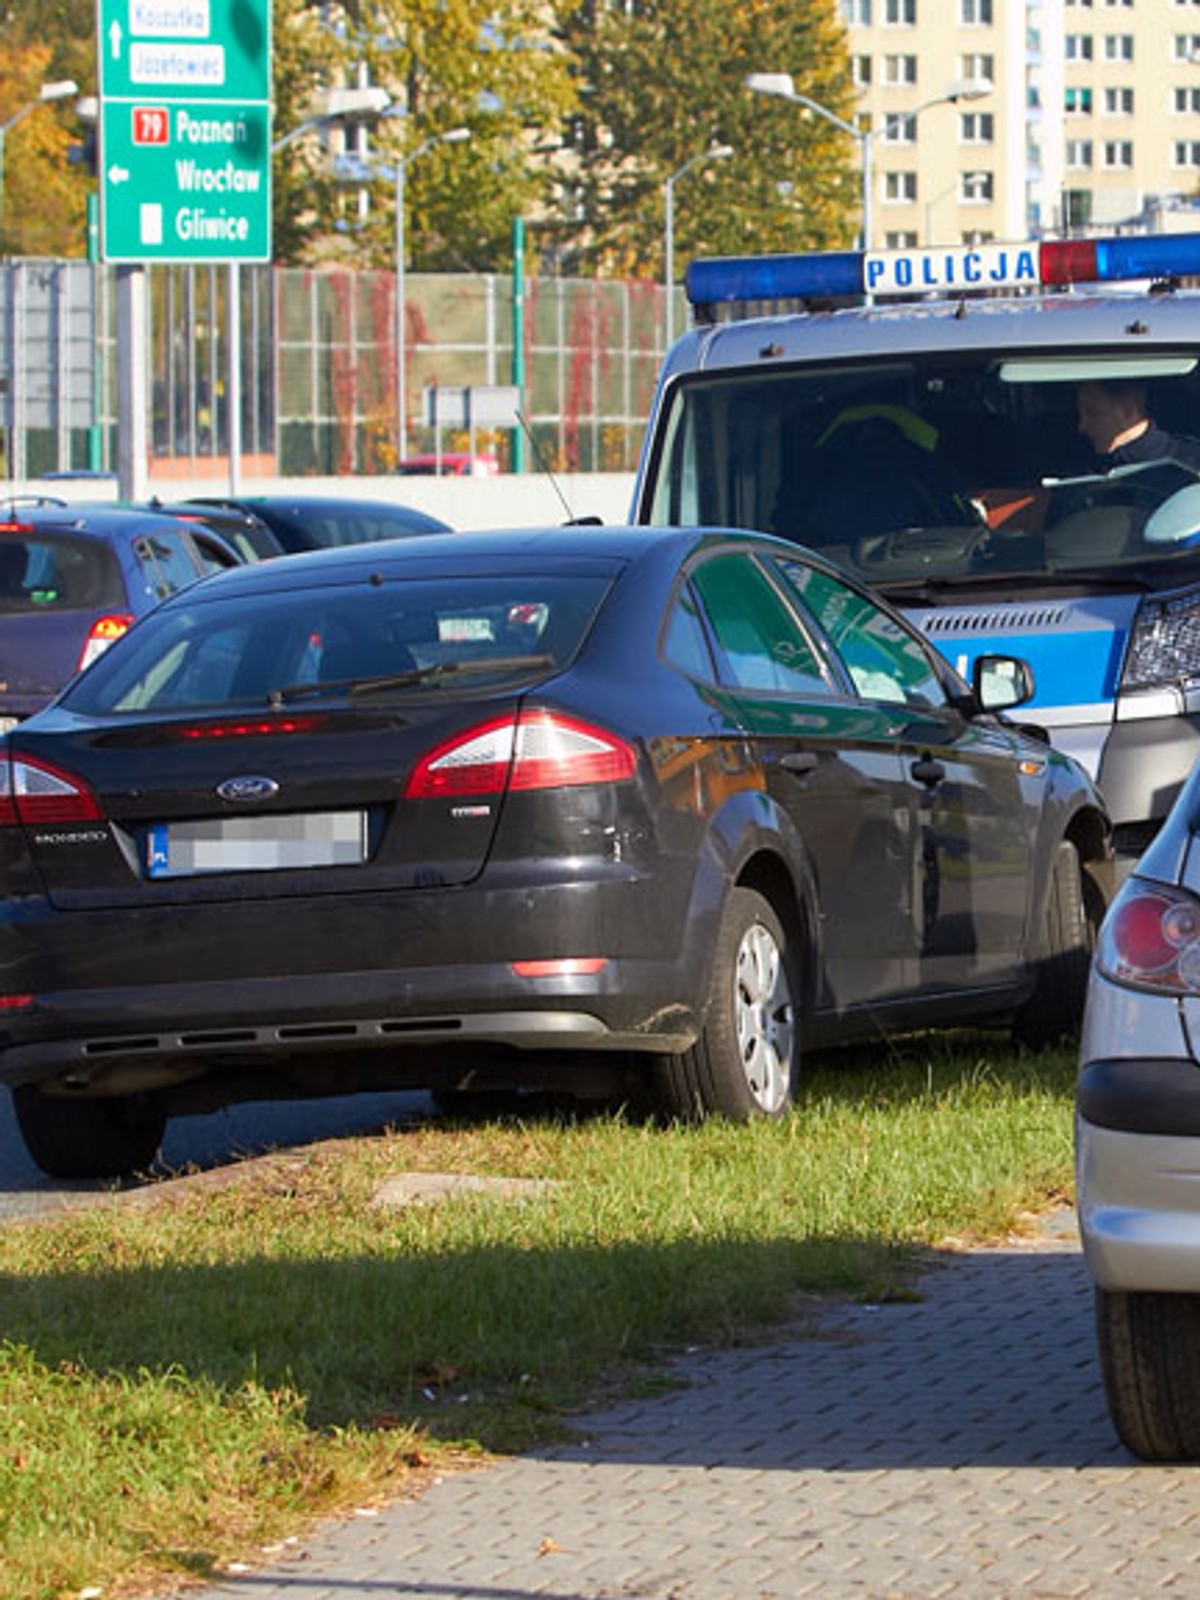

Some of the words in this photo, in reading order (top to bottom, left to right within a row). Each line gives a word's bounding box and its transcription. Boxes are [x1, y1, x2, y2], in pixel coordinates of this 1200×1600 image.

[141, 112, 163, 140] 79
[176, 110, 247, 143] Poznań
[175, 158, 261, 192] Wrocław
[175, 206, 249, 241] Gliwice
[867, 251, 1035, 288] POLICJA
